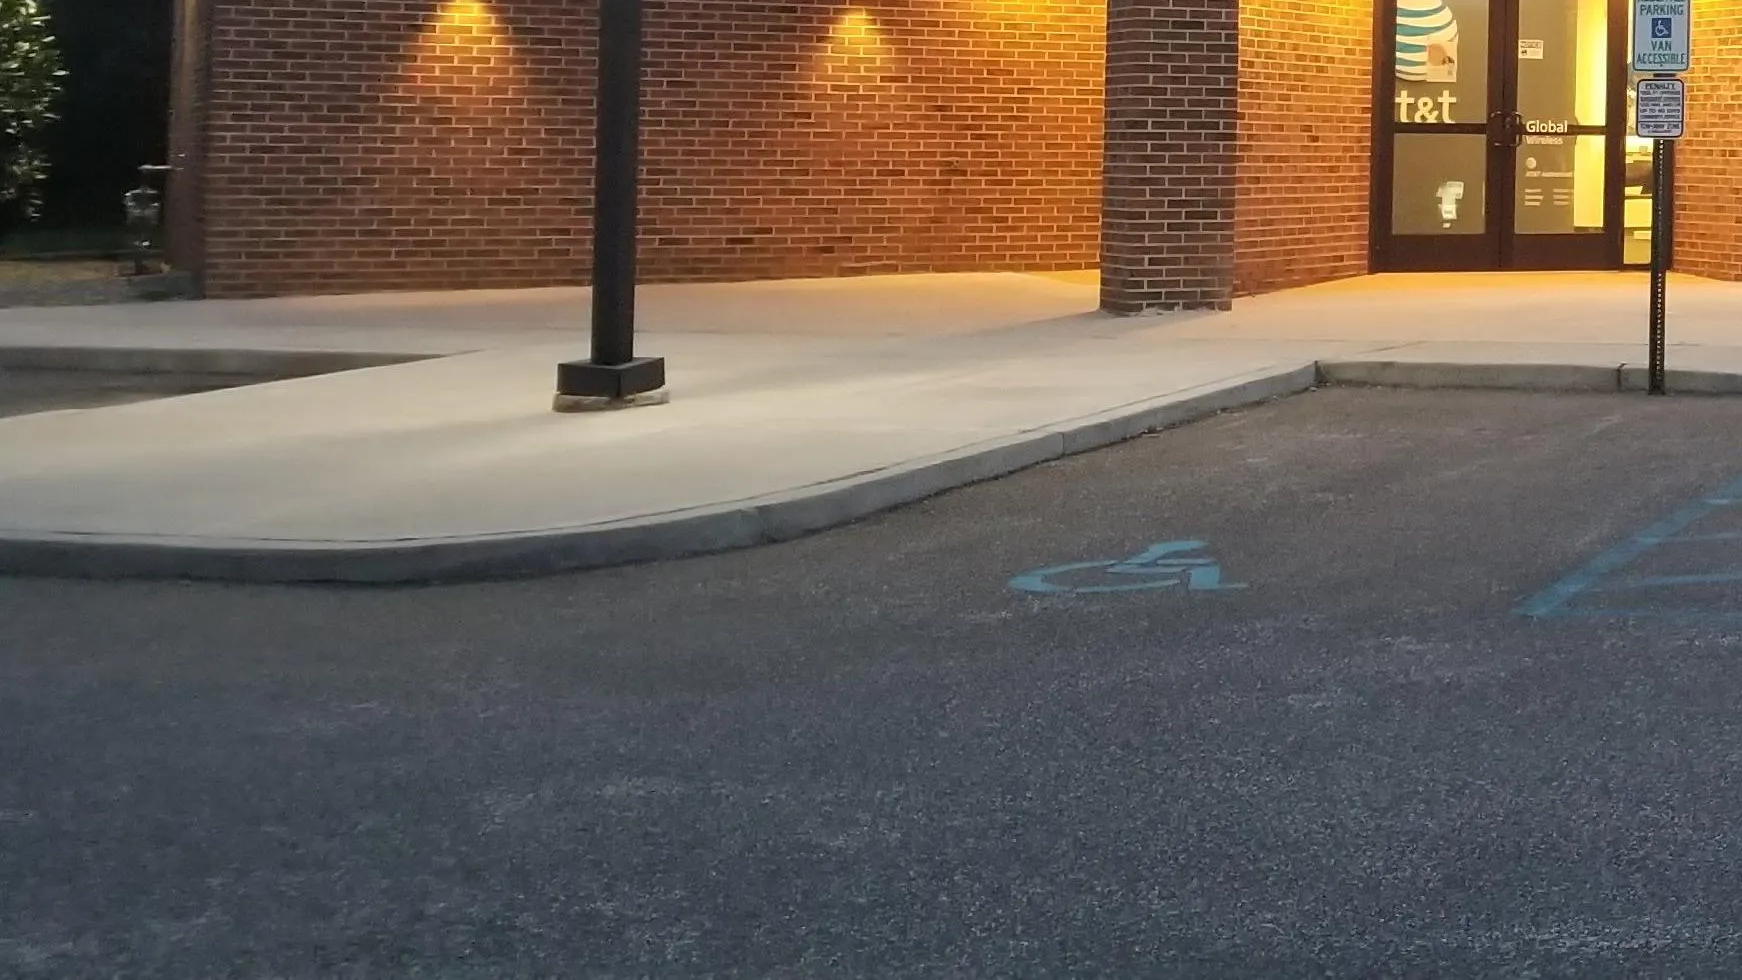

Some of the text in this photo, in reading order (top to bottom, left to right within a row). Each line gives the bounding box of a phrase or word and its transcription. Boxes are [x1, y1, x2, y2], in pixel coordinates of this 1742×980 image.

[1639, 4, 1684, 16] PARKING
[1650, 40, 1672, 52] VAN
[1636, 52, 1686, 65] ACCESSIBLE
[1525, 120, 1568, 133] Global
